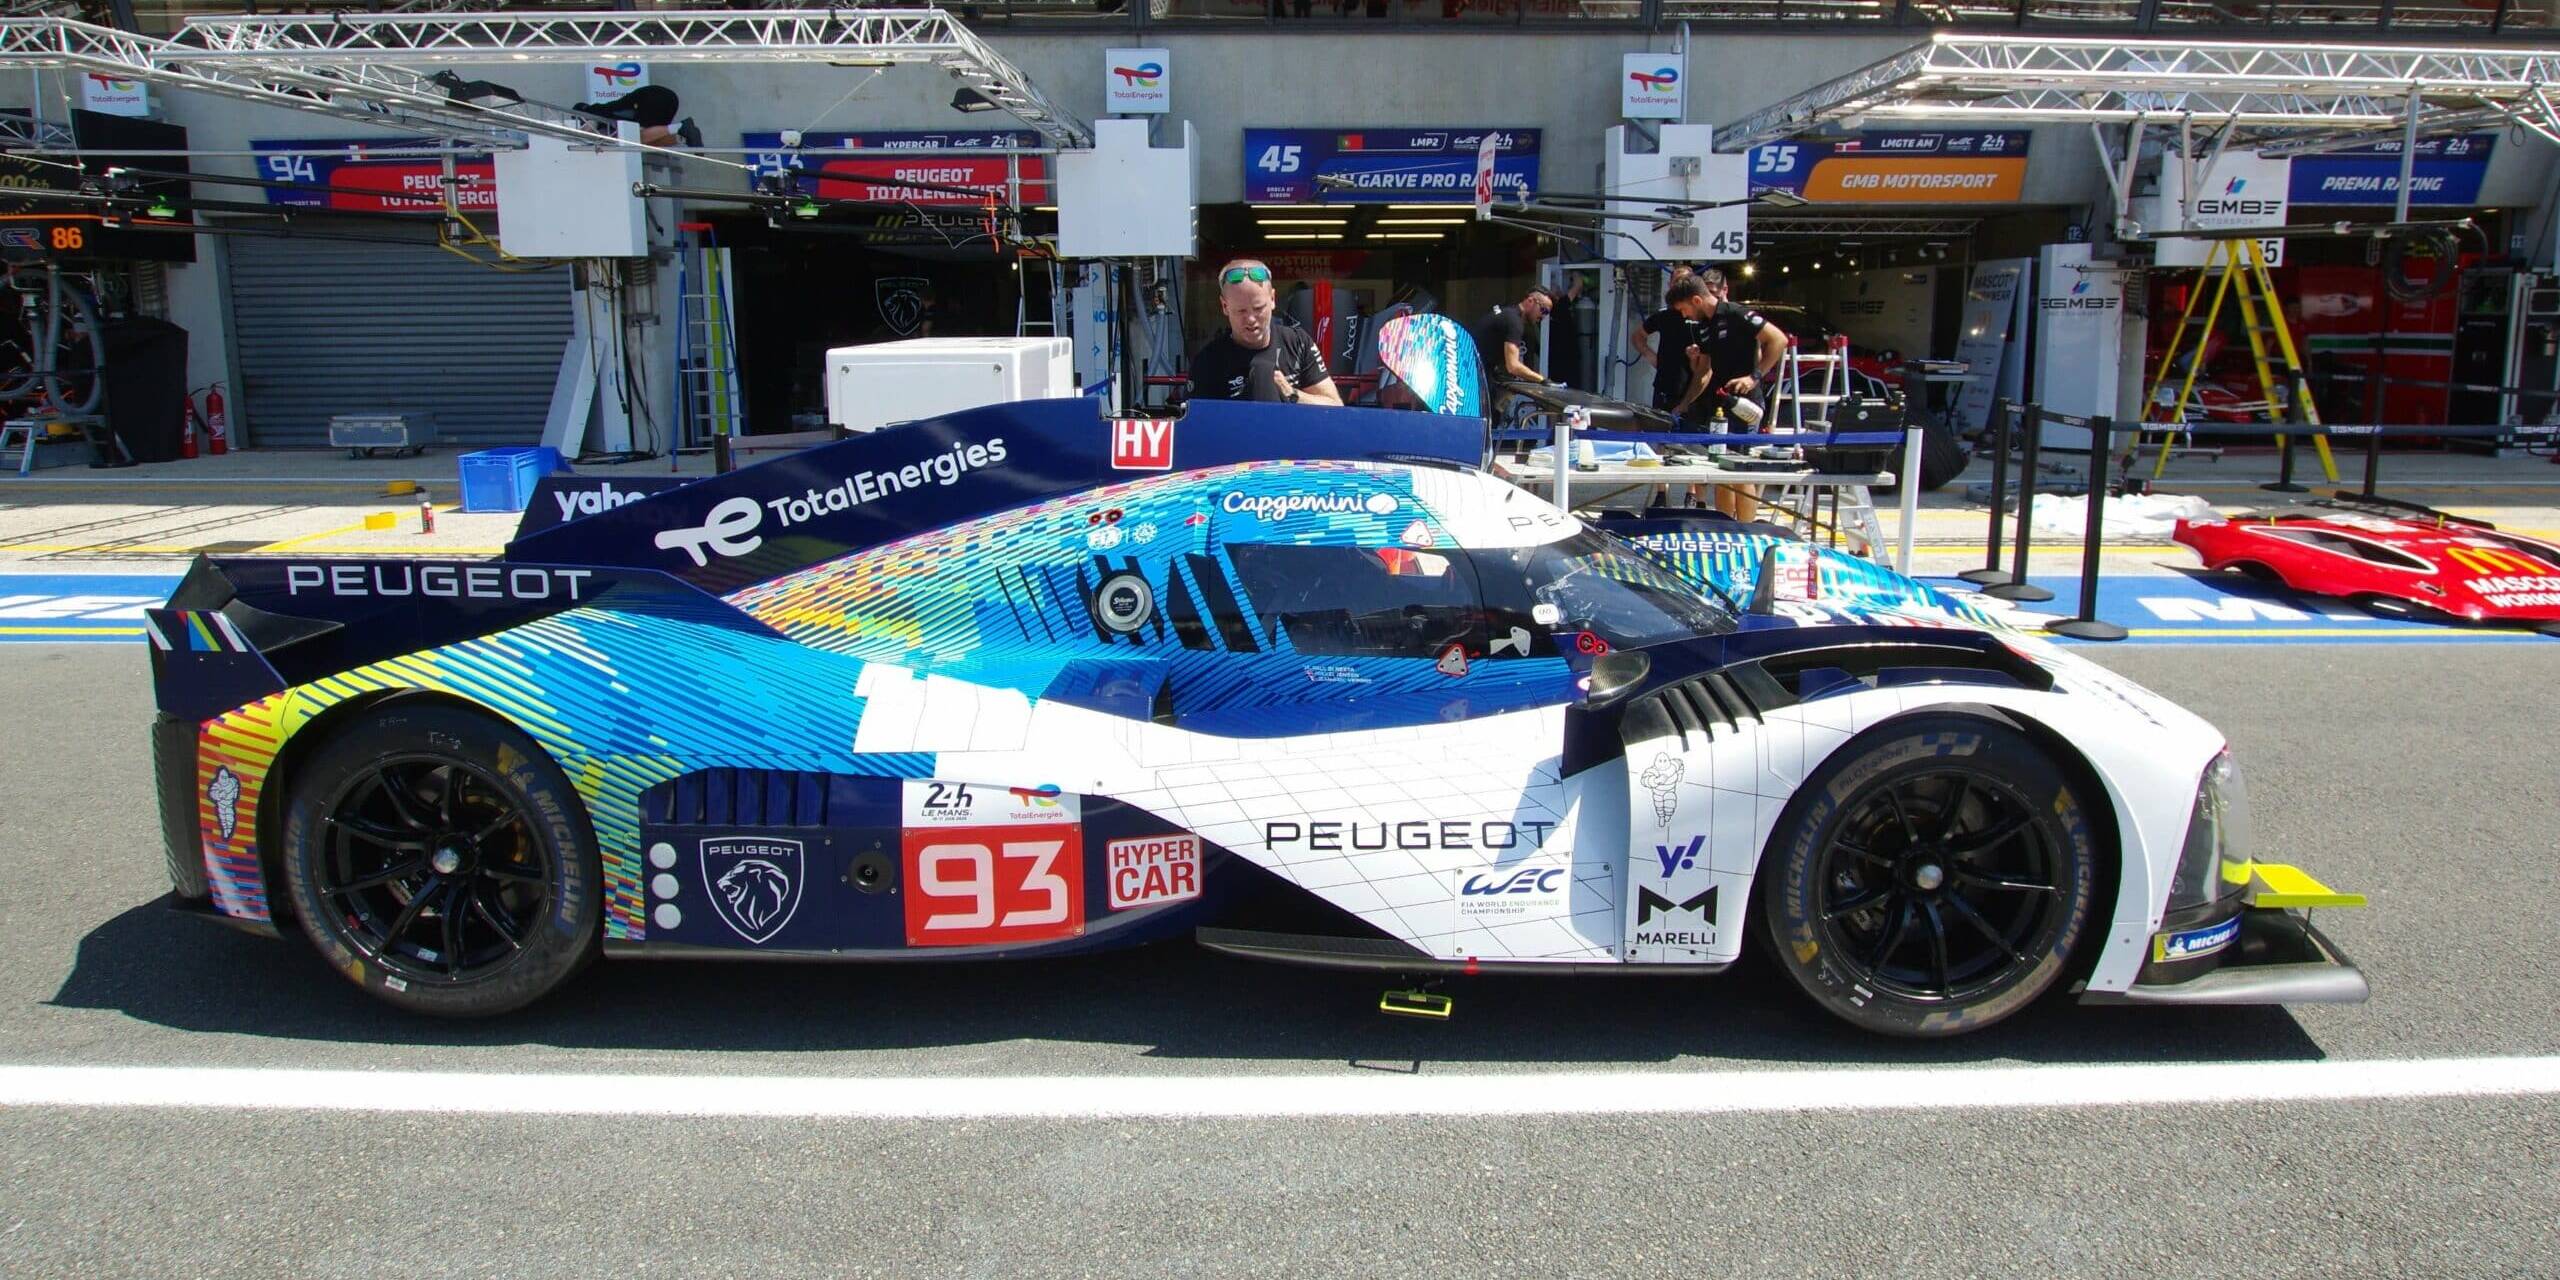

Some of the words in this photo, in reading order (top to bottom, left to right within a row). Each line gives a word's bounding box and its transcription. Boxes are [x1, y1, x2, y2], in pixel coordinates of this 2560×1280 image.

[1114, 91, 1163, 99] TotalEnergies
[1630, 96, 1678, 104] TotalEnergies
[1411, 138, 1439, 146] LMP2
[1881, 138, 1915, 148] LMGTE
[1917, 138, 1934, 148] AM
[269, 156, 315, 182] 94
[1258, 145, 1301, 172] 45
[1756, 146, 1798, 172] 55
[403, 174, 480, 190] PEUGOT
[895, 168, 974, 183] PEUGEOT
[1421, 173, 1456, 187] PRO
[1460, 173, 1524, 187] RAING
[1841, 174, 1880, 187] GMB
[1882, 174, 1997, 187] MOTORSPORT
[2321, 177, 2381, 190] PREMA
[2198, 200, 2261, 214] GMB
[52, 227, 83, 249] 86
[1711, 231, 1744, 254] 45
[2048, 298, 2104, 309] GMB
[1117, 421, 1168, 459] HY
[767, 435, 1007, 528] TotalEnergies
[1223, 491, 1364, 521] Capgemini
[1632, 541, 1746, 554] PEUGEOT
[287, 565, 592, 600] PEUGEOT
[1010, 811, 1063, 819] TotalEnergies
[1266, 822, 1556, 851] PEUGEOT
[532, 789, 583, 924] MICHELIN
[709, 846, 794, 857] PEUGEOT
[1114, 839, 1194, 867] HYPER
[1787, 800, 1829, 918] MICHELIN
[919, 840, 1069, 931] 93
[1115, 861, 1195, 902] CAR
[1462, 868, 1565, 896] WEC
[1636, 932, 1716, 945] MARELLI
